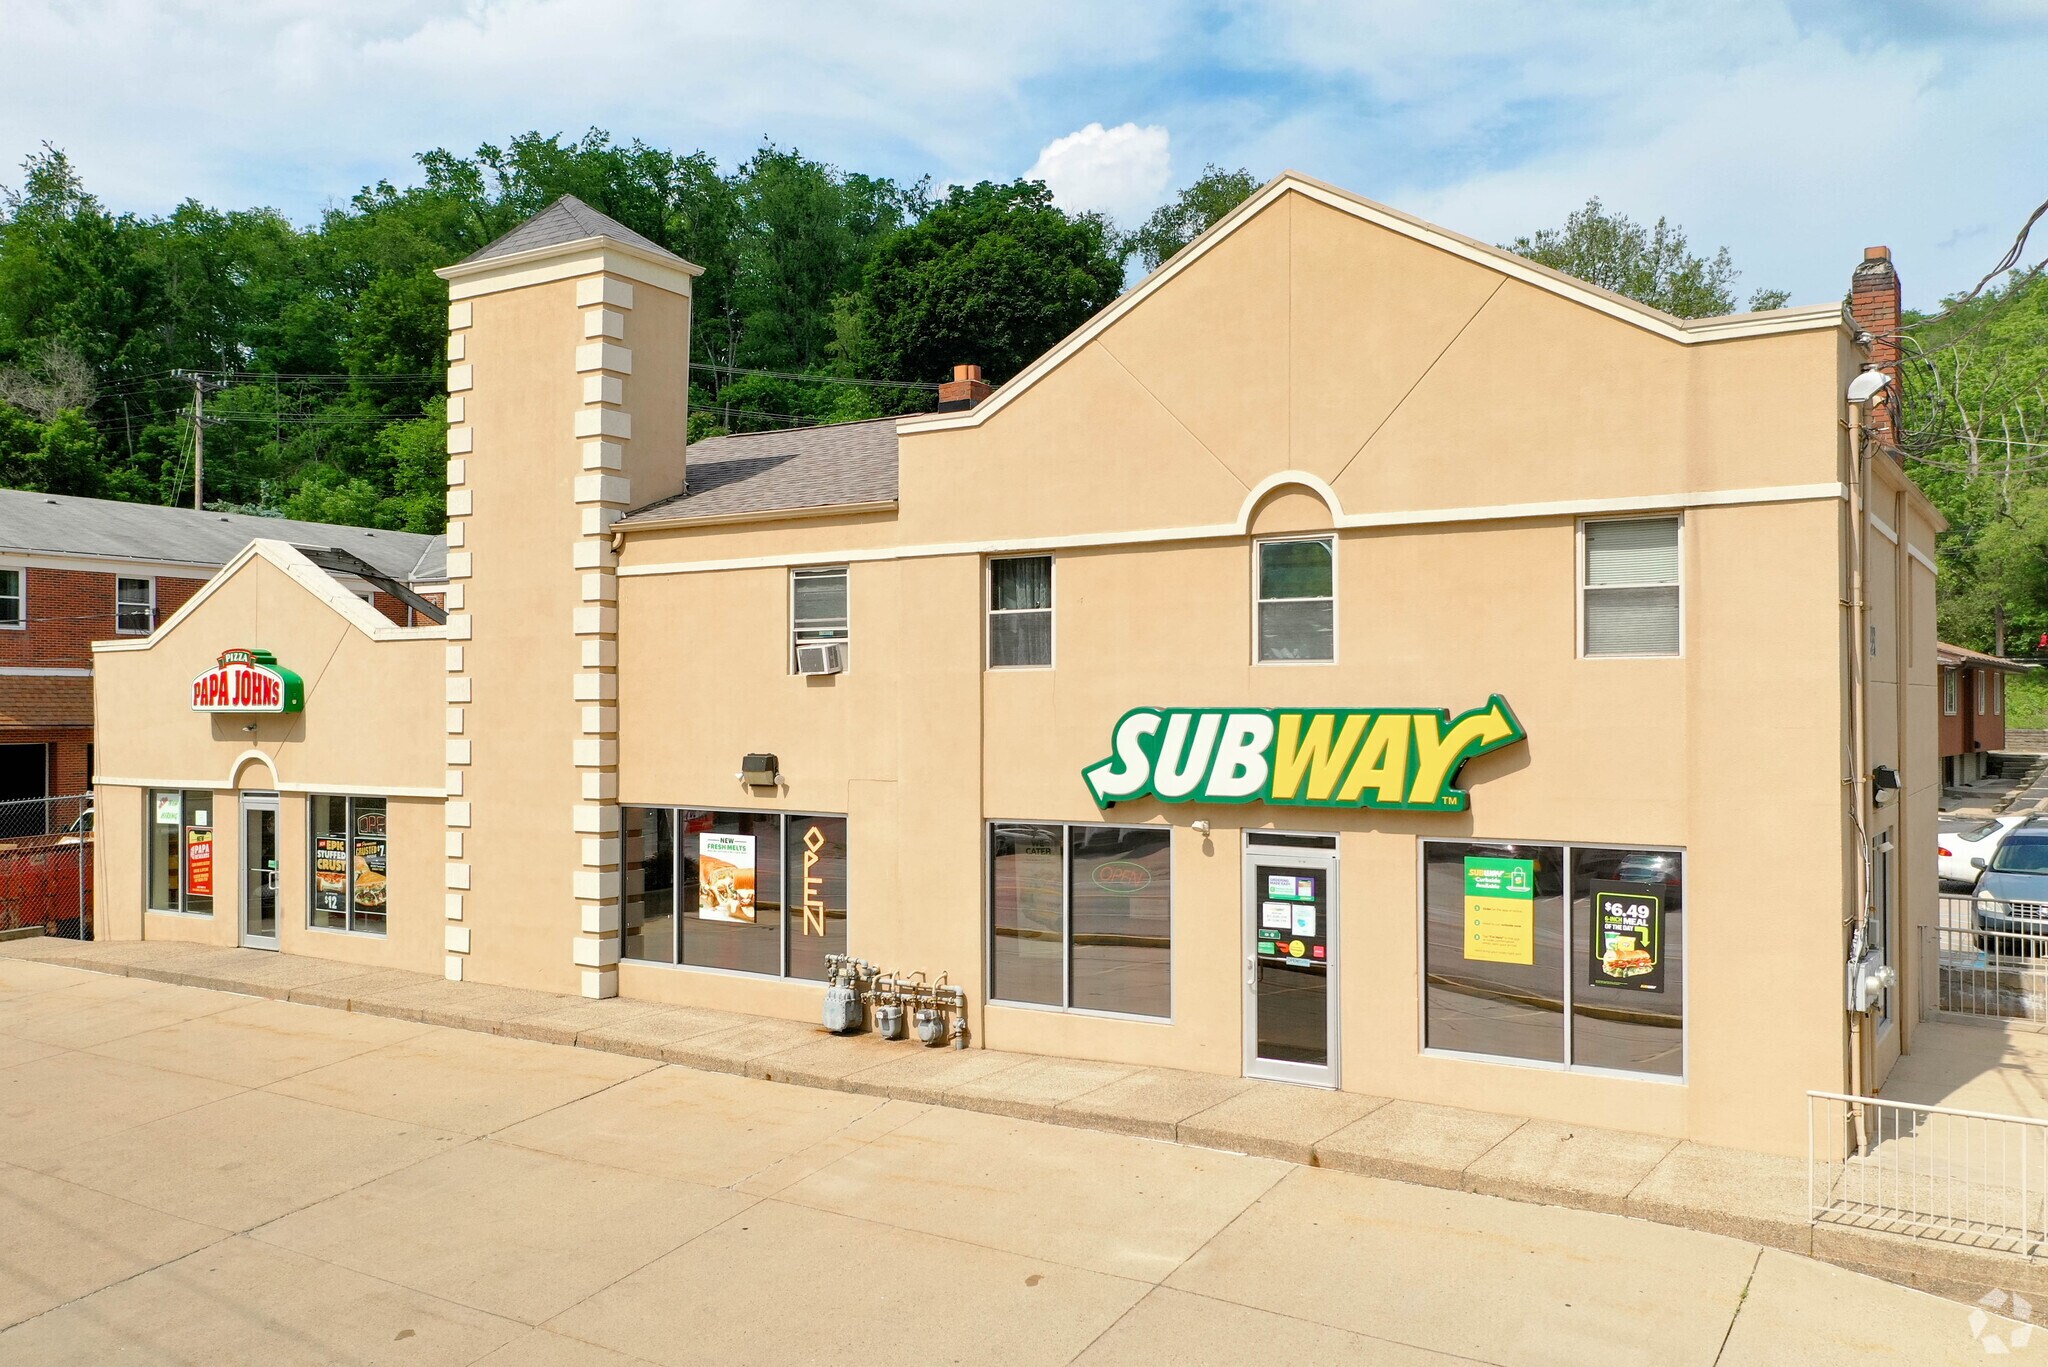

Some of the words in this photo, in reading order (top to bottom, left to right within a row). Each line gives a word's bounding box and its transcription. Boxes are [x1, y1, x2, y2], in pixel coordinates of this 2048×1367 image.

[225, 652, 248, 663] PIZZA
[193, 670, 229, 706] PAPA
[1088, 704, 1513, 804] SUBWAY
[1441, 796, 1458, 806] TM
[194, 843, 210, 855] PAPA
[326, 840, 344, 850] EPIC
[1031, 839, 1045, 847] WE
[317, 850, 346, 859] STUFFED
[1025, 847, 1051, 855] CATER
[317, 858, 345, 871] CRUST
[803, 826, 825, 937] OPEN
[1100, 866, 1145, 885] OPEN
[324, 895, 338, 909] $12
[1604, 901, 1650, 919] $6.49
[1623, 917, 1648, 926] MEAL
